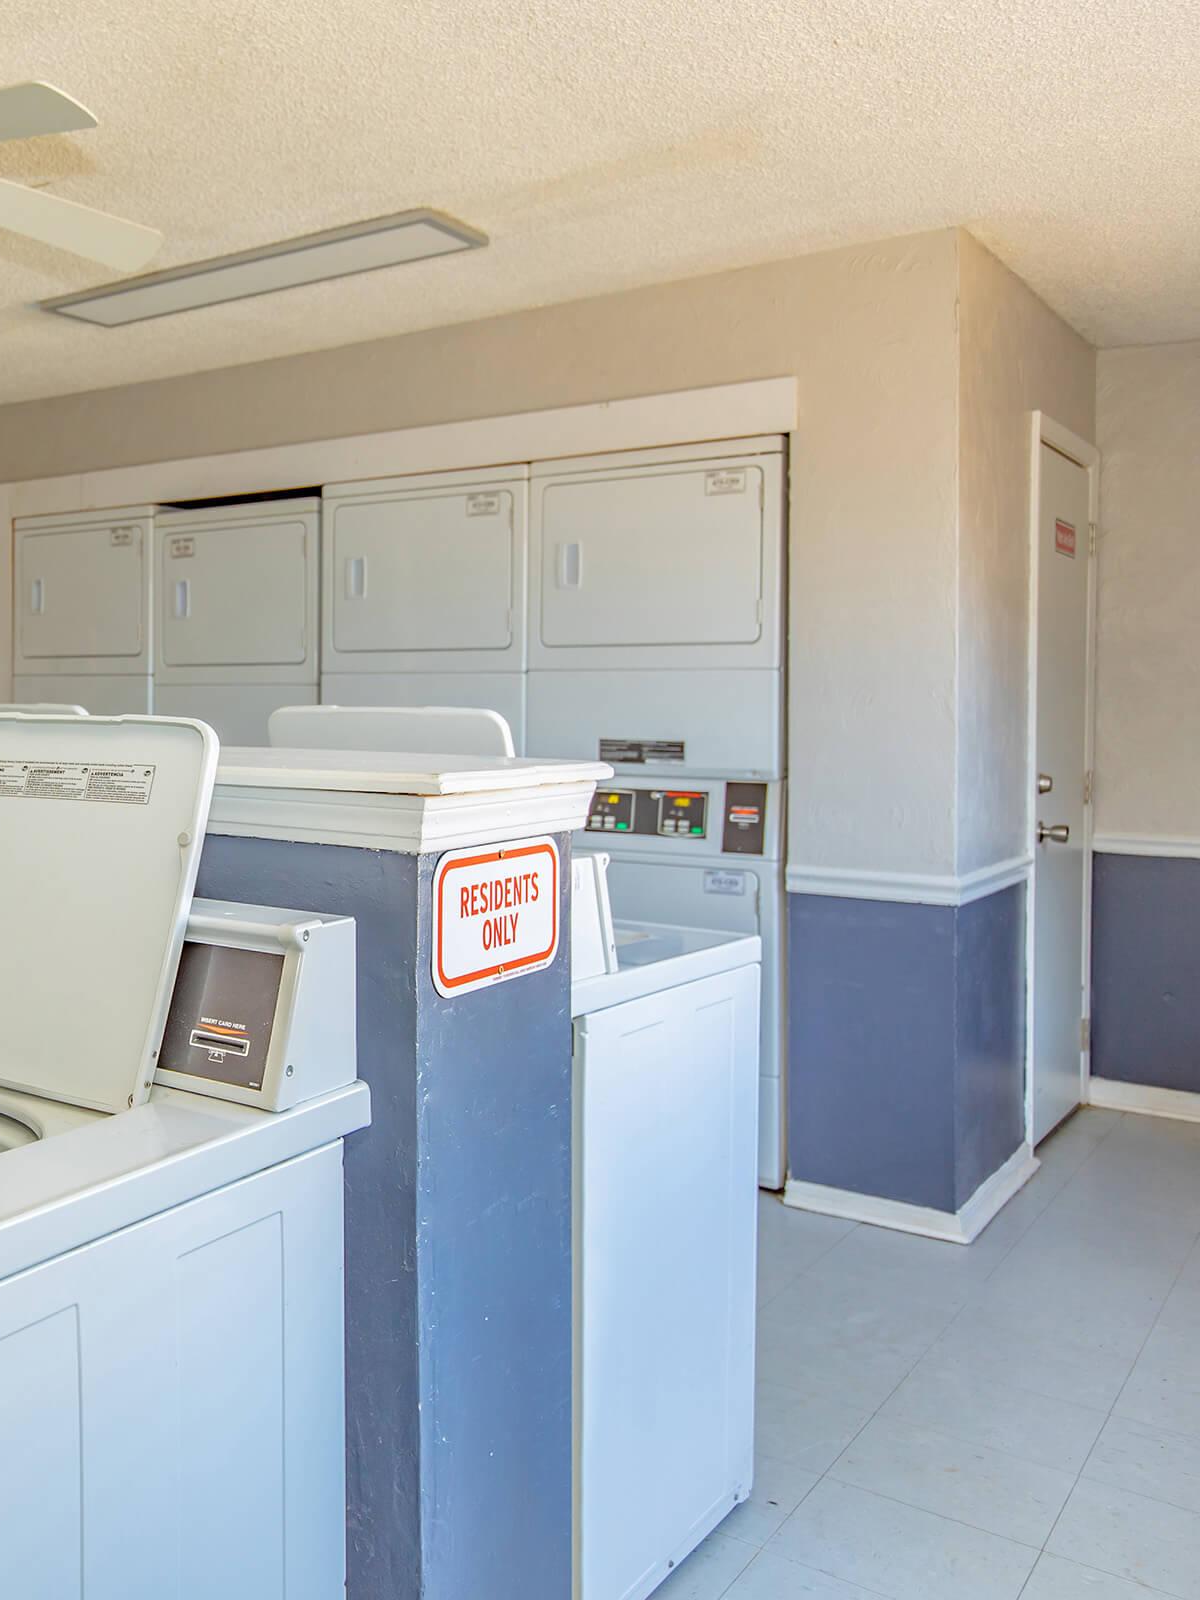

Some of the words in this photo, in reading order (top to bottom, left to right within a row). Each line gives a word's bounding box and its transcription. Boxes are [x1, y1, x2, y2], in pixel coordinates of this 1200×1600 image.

[460, 871, 539, 919] RESIDENTS
[482, 912, 519, 951] ONLY
[200, 1016, 218, 1025] INSERT
[218, 1019, 232, 1028] CARD
[232, 1022, 246, 1031] HERE
